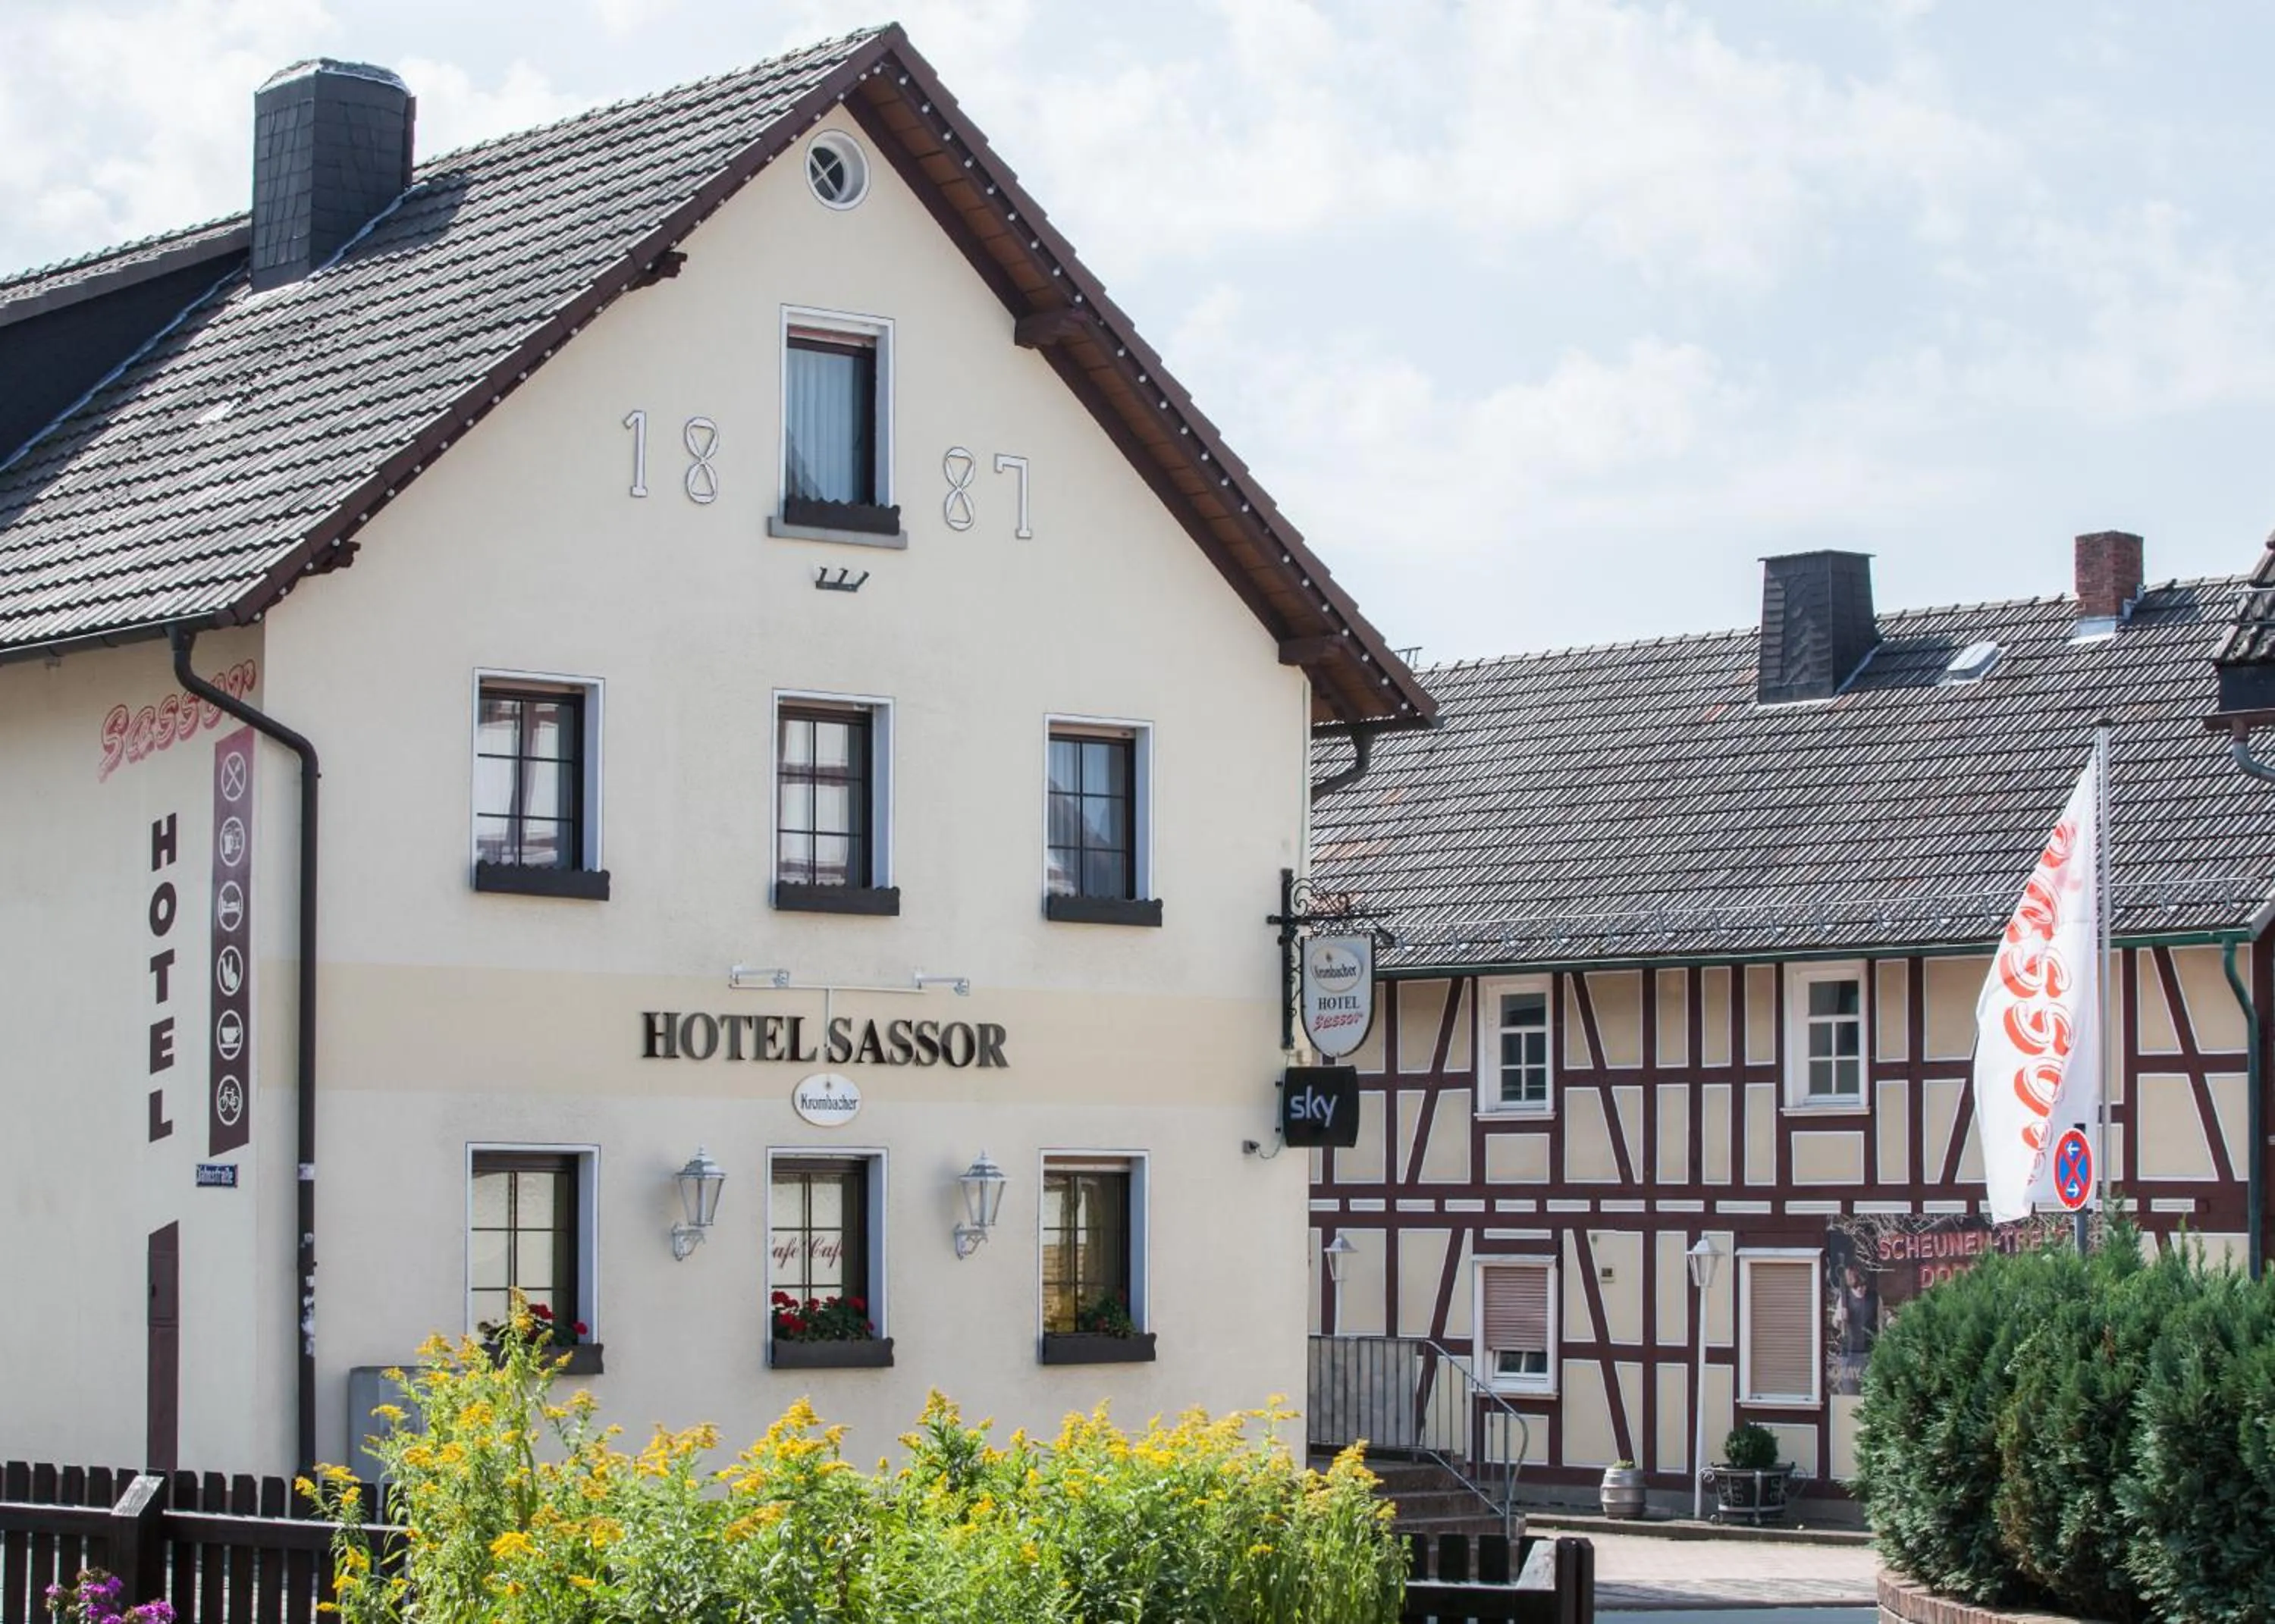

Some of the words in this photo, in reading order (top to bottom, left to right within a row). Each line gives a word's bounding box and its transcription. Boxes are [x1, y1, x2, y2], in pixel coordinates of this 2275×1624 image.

[148, 812, 177, 1143] HOTEL
[1318, 995, 1361, 1011] HOTEL
[642, 1011, 817, 1061] HOTEL
[827, 1017, 1010, 1068] SASSOR
[800, 1093, 858, 1111] Krombacher
[1290, 1085, 1339, 1129] sky
